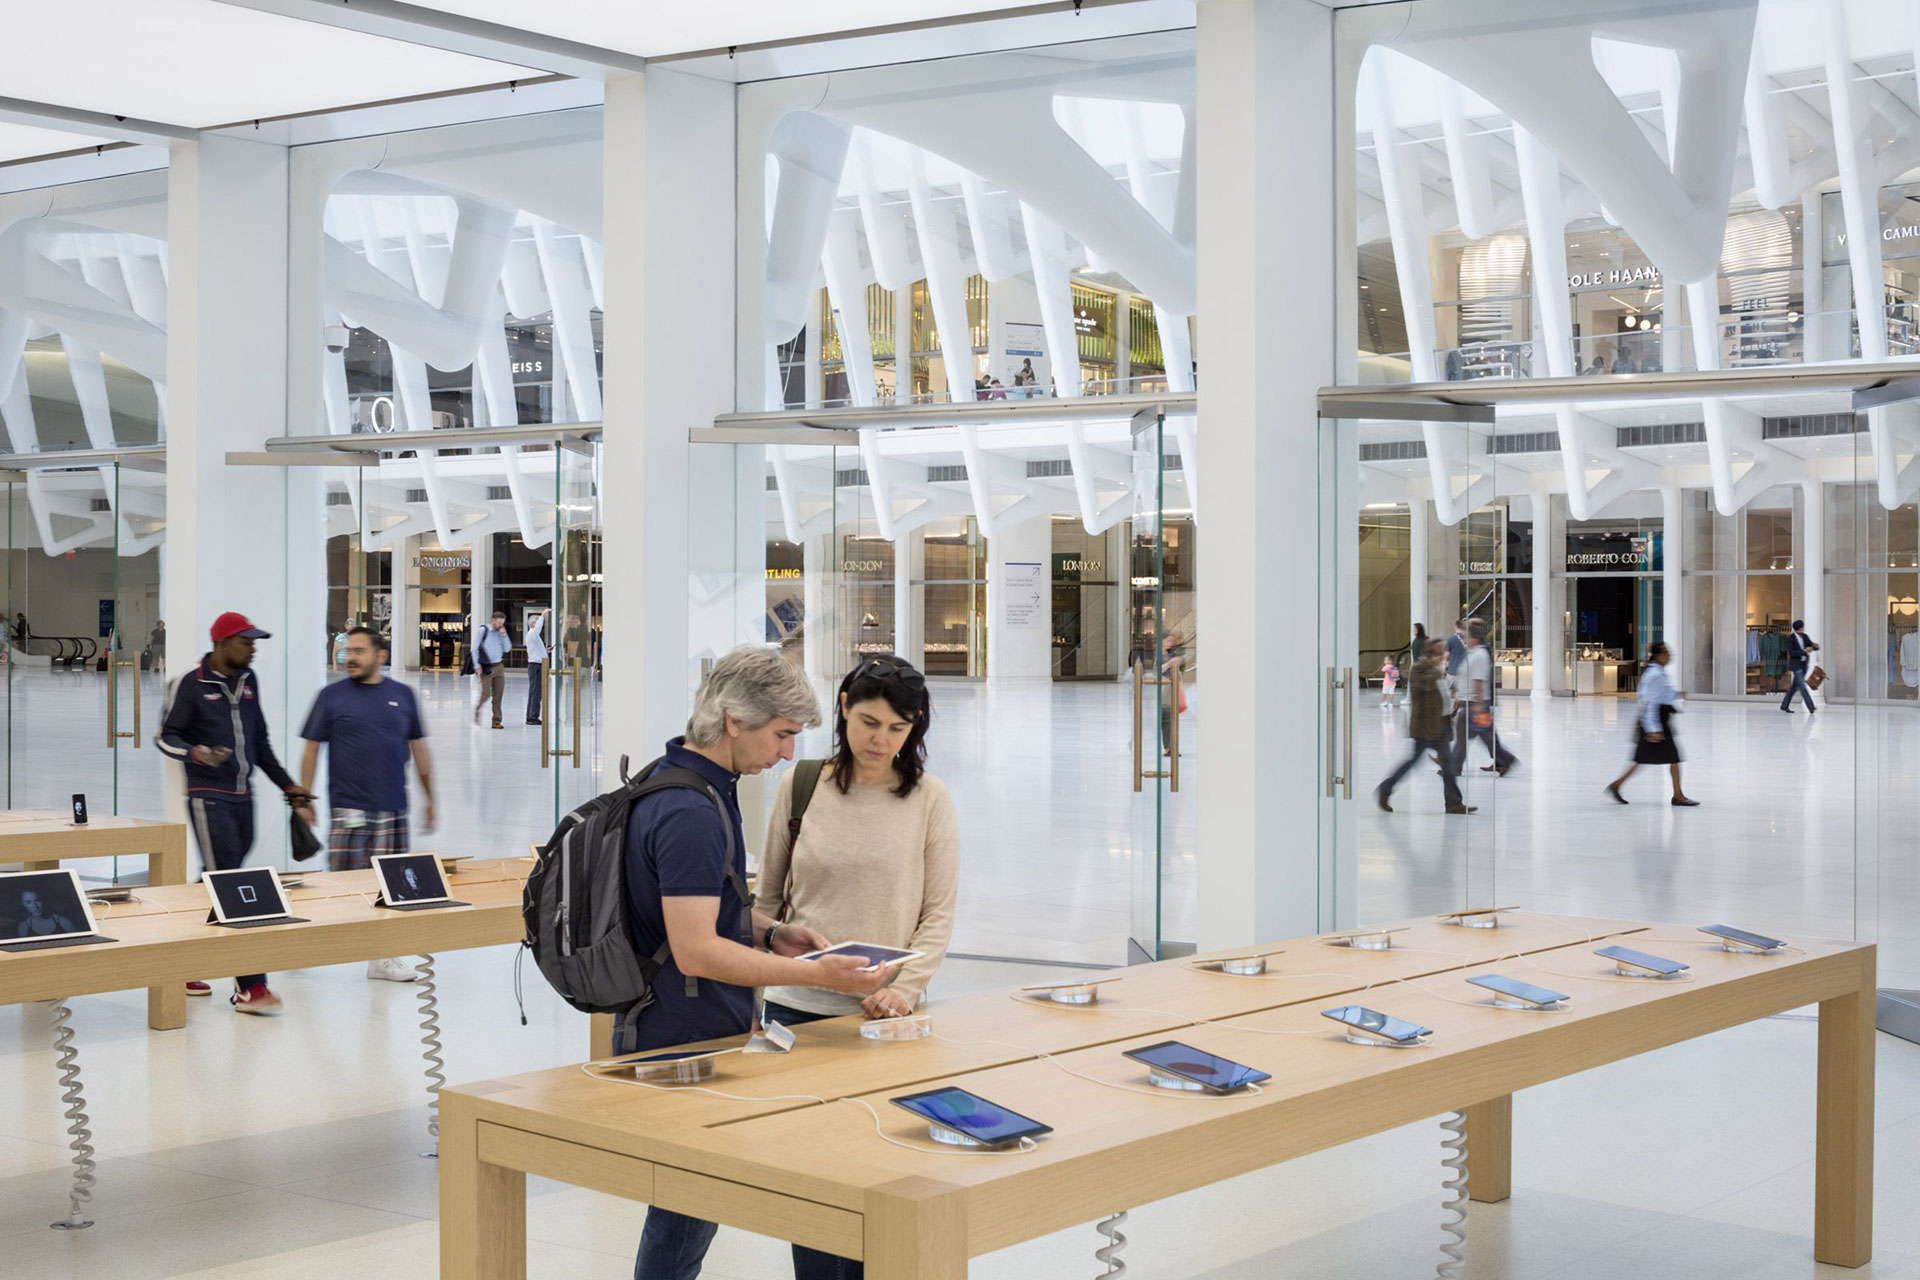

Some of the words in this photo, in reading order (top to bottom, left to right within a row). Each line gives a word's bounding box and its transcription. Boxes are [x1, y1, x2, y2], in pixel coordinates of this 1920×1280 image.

[1610, 266, 1656, 283] HAAN
[1743, 298, 1769, 310] FEEL
[1567, 553, 1619, 564] ROBERTO
[1063, 560, 1101, 571] LONDON
